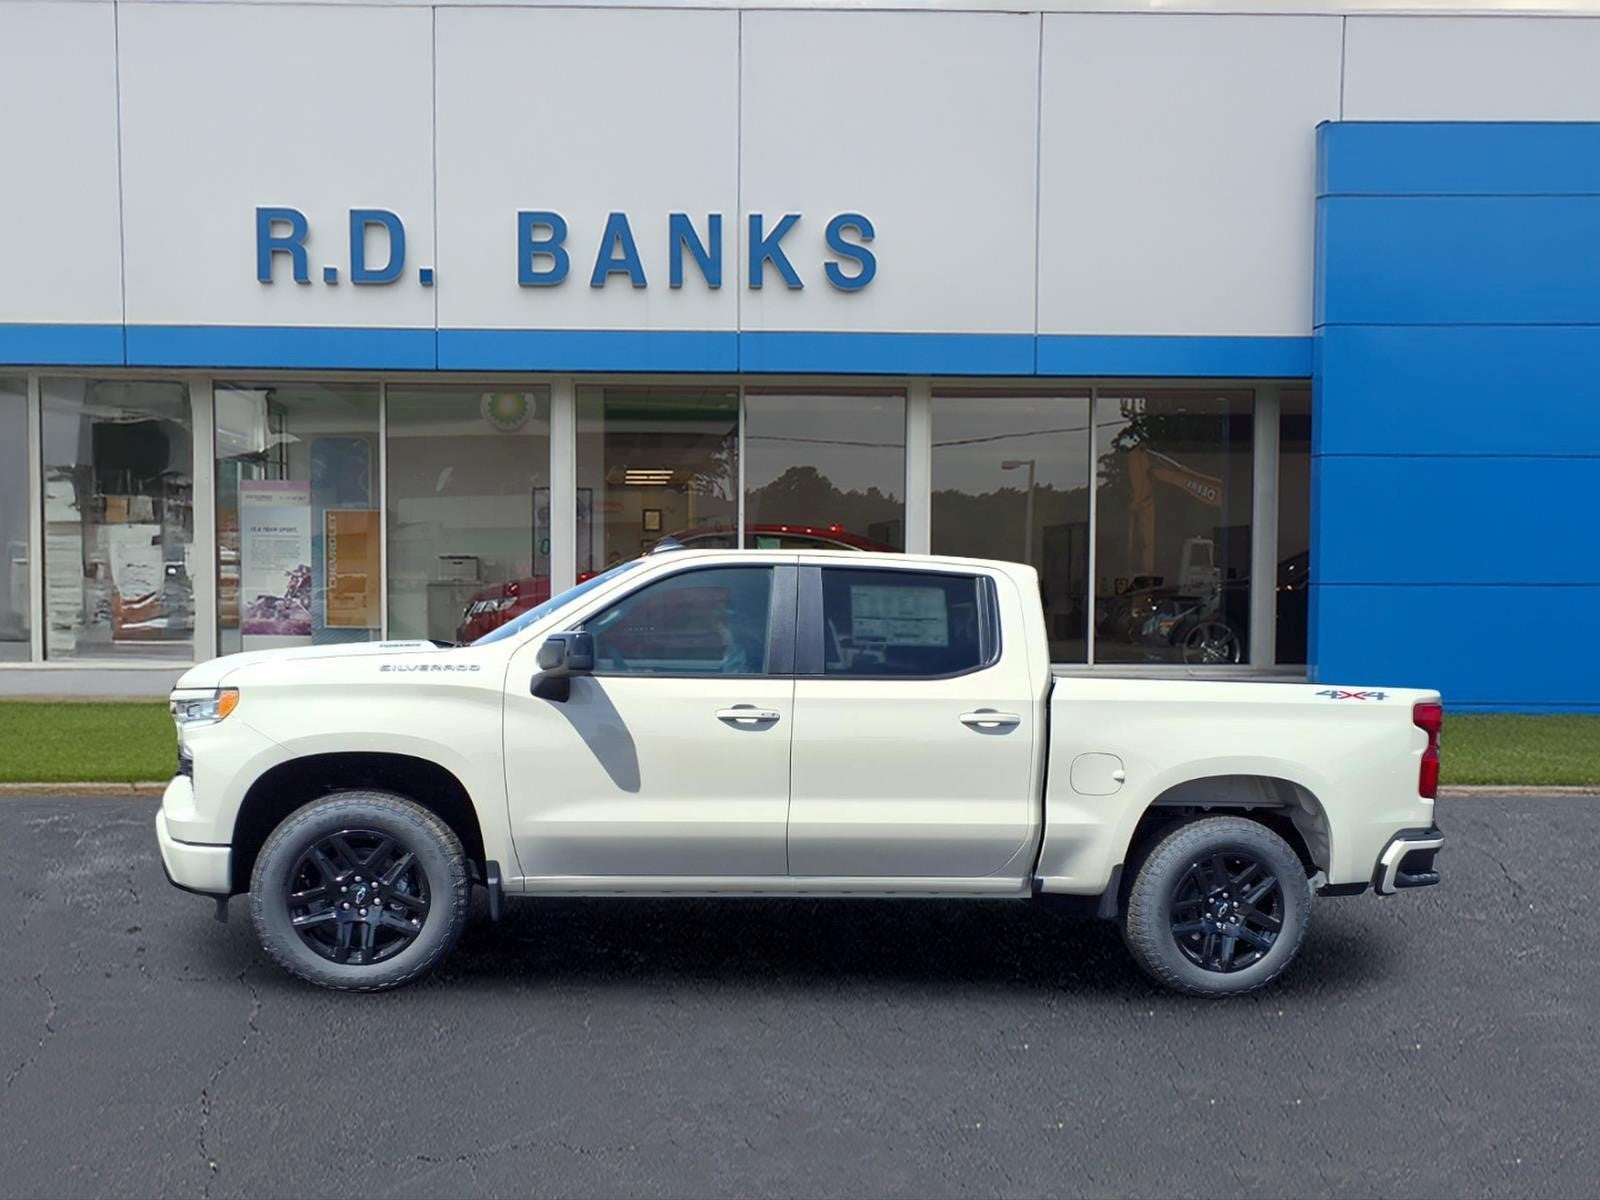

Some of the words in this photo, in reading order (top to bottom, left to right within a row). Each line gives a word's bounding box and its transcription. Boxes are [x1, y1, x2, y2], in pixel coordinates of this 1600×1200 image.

[255, 205, 435, 285] R.D.
[517, 210, 877, 293] BANKS
[328, 512, 337, 589] CHEVROLET
[379, 664, 481, 672] SILVERADO
